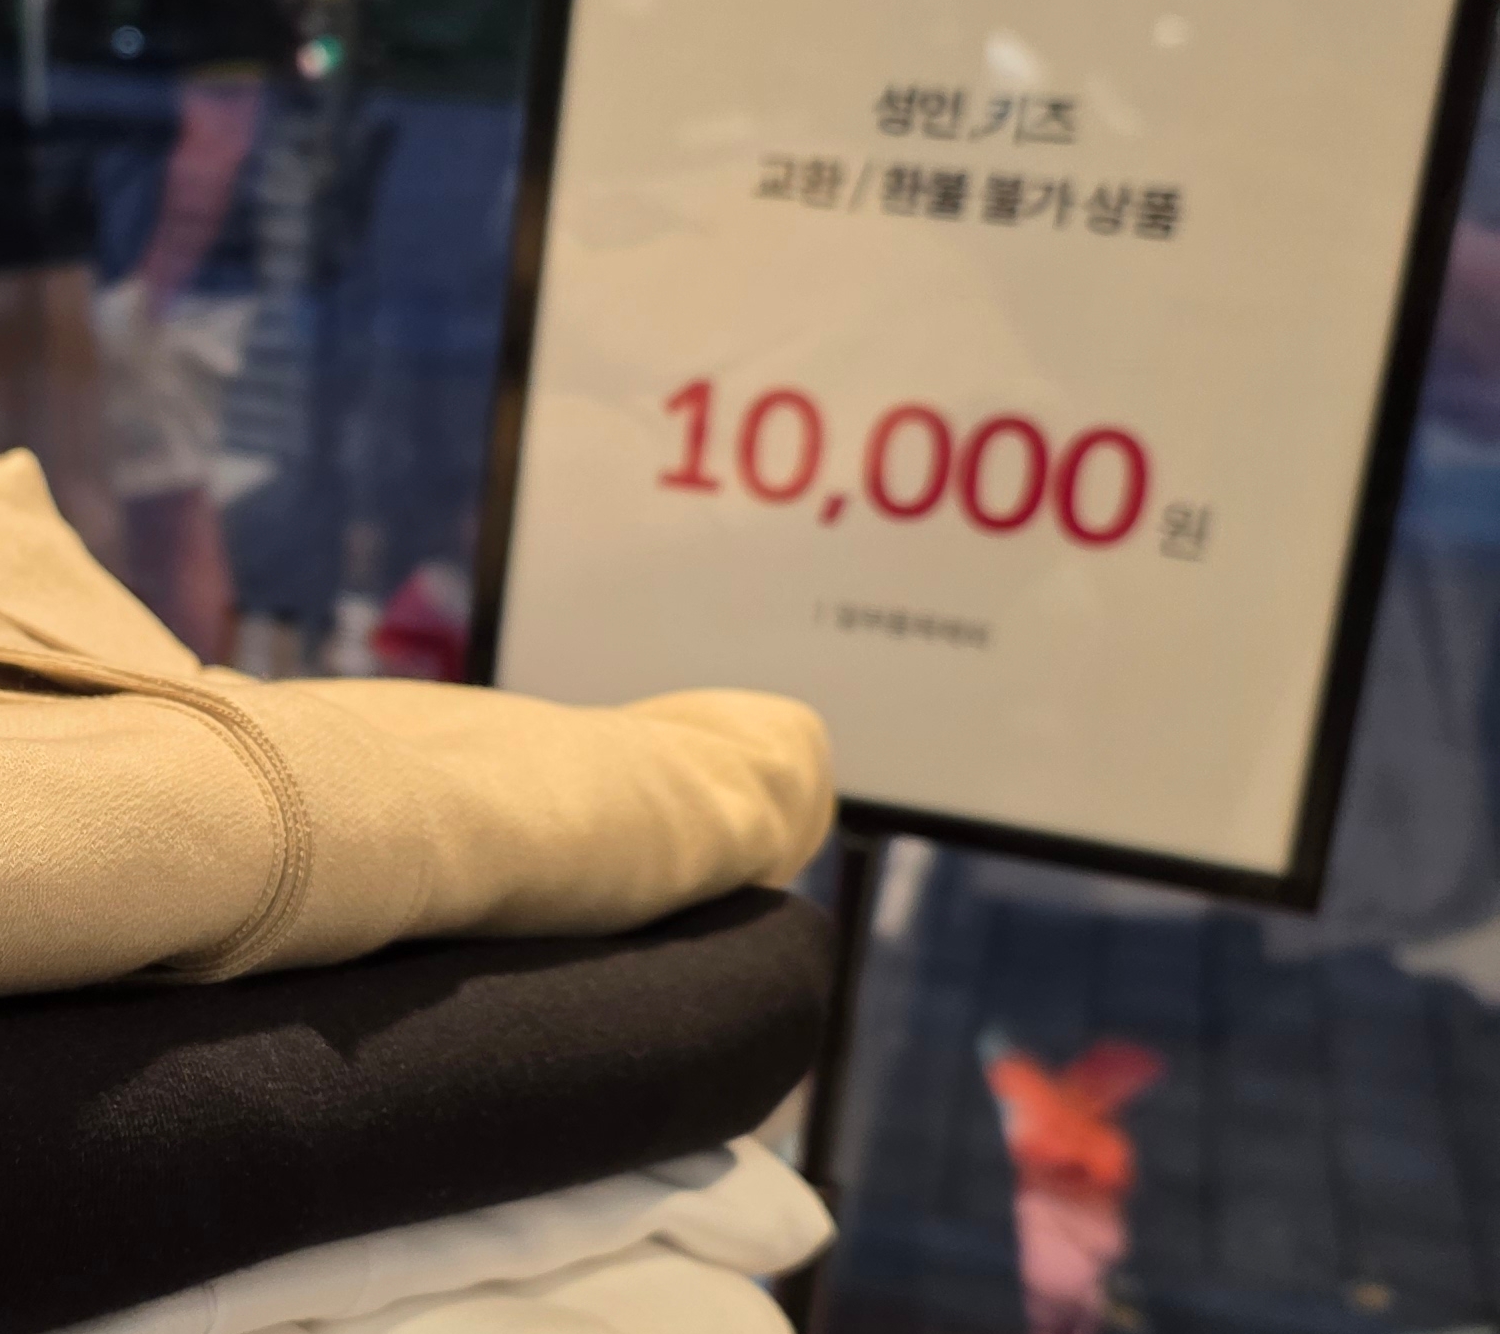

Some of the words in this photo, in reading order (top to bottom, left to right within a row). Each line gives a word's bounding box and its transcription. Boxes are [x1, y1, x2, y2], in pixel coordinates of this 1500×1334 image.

[754, 154, 842, 207] 교환
[881, 163, 968, 220] 환불
[982, 170, 1074, 227] 불가
[1084, 181, 1182, 241] 상품
